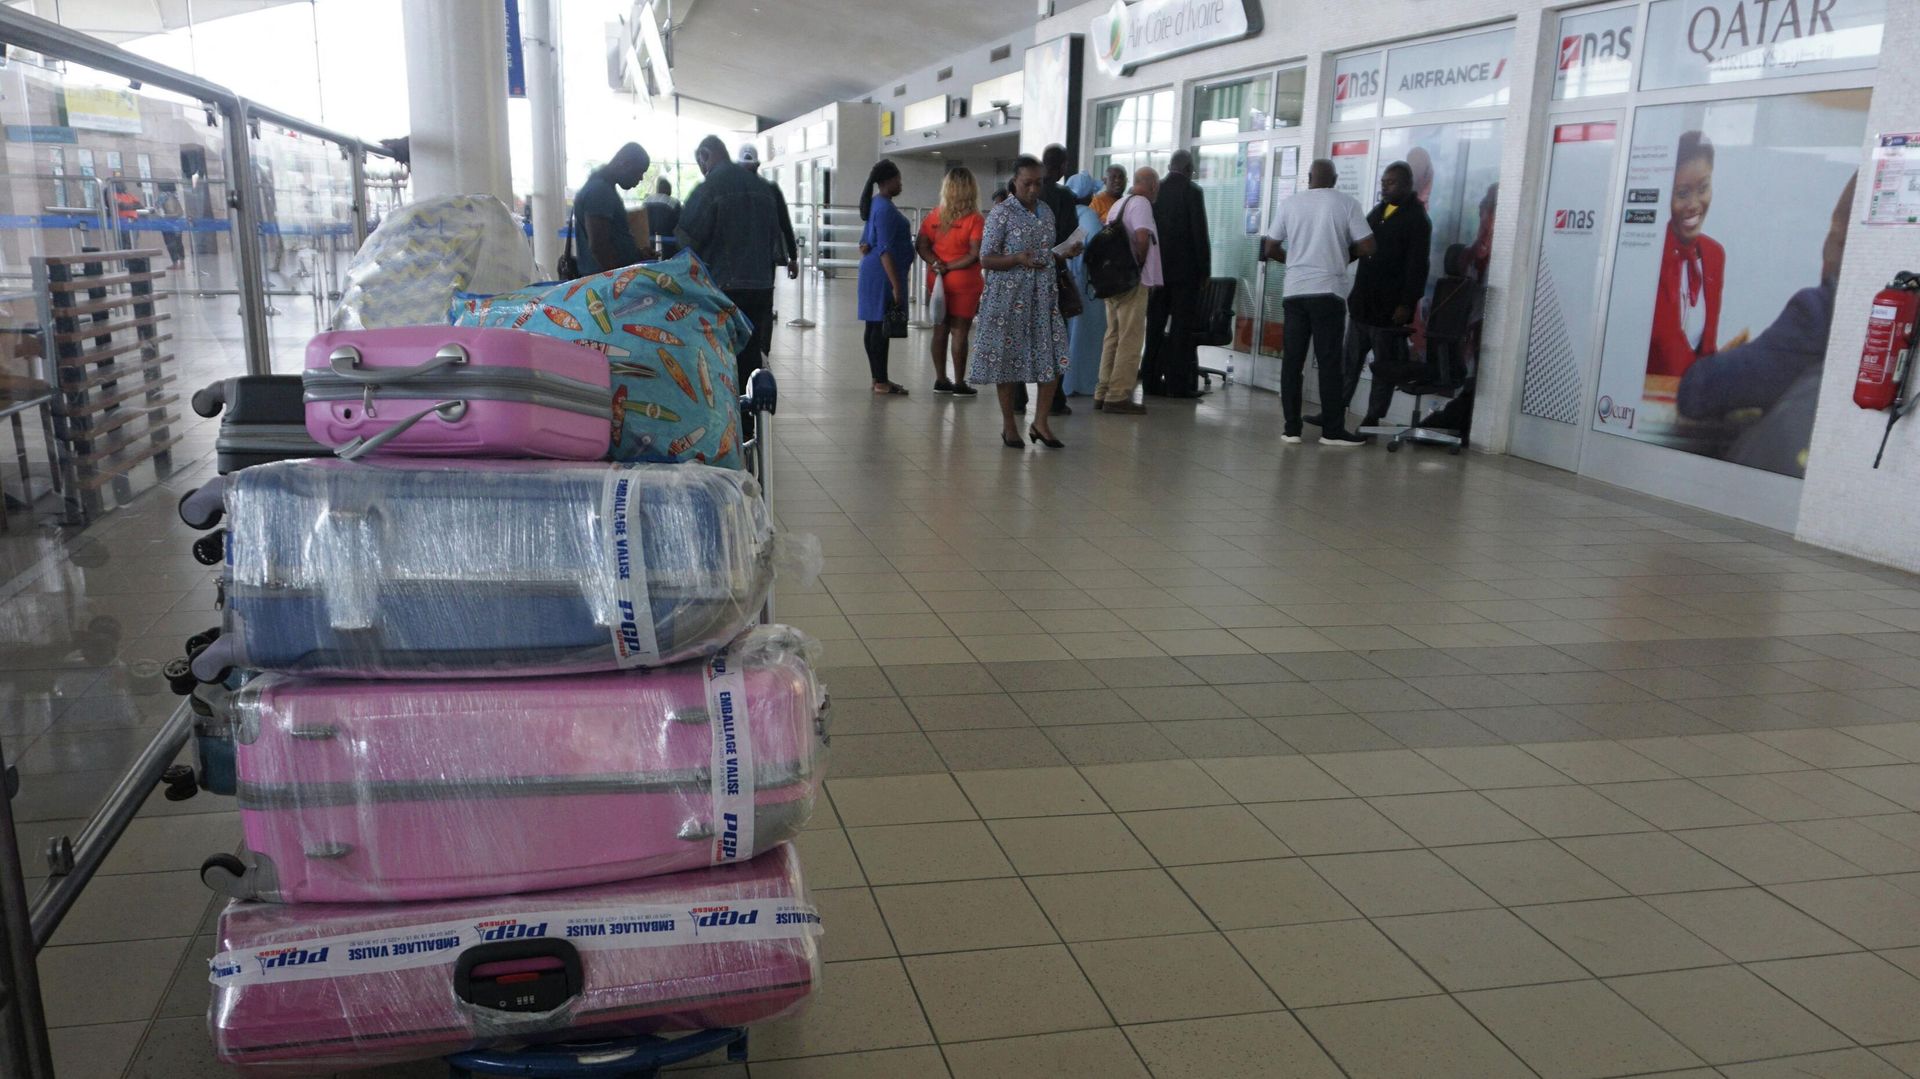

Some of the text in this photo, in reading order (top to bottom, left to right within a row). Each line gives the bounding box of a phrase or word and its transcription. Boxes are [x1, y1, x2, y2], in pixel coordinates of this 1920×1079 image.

[1127, 19, 1144, 48] Air
[1146, 10, 1172, 44] Côte
[1688, 0, 1835, 62] QATAR
[1582, 26, 1632, 67] nas
[1349, 68, 1379, 98] nas
[1398, 62, 1490, 91] AIRFRANCE
[1567, 209, 1595, 229] nas
[615, 479, 630, 580] EMBALLAGE VALISE
[720, 692, 737, 755] EMBALLAGE
[727, 758, 739, 796] VALISE
[478, 919, 517, 928] EXPRESS
[566, 920, 675, 937] EMBALLAGE VALISE
[348, 936, 460, 960] EMBALLAGE VALISE
